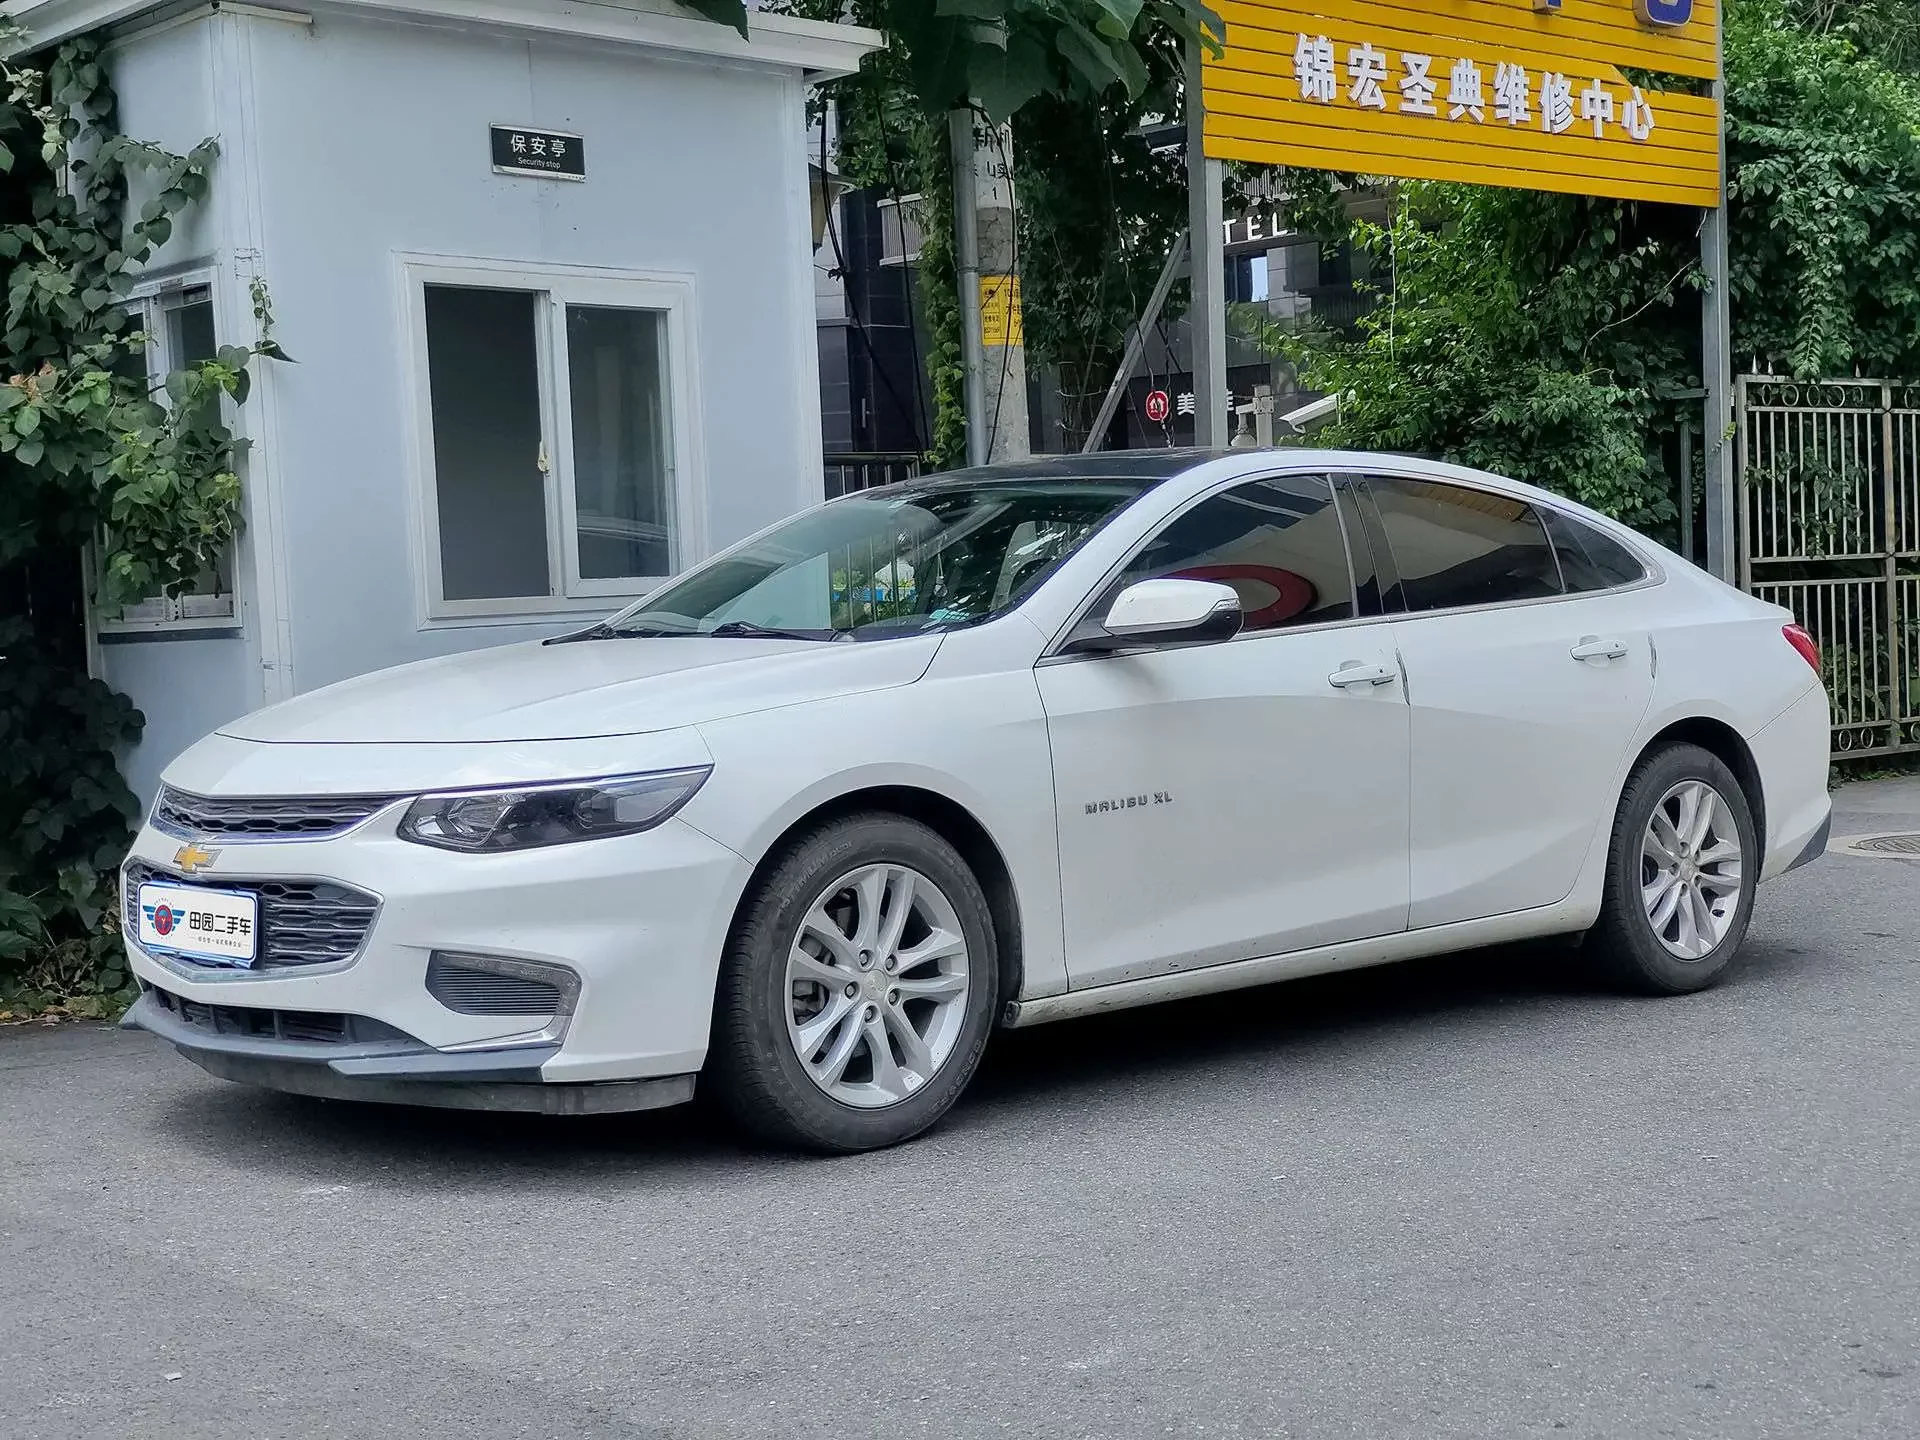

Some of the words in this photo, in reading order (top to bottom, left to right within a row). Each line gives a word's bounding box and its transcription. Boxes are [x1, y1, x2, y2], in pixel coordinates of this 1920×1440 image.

[1292, 32, 1655, 140] 锦宏圣典维修中心
[510, 133, 566, 157] 保安亭
[518, 157, 545, 168] Security
[546, 161, 561, 169] stop
[1085, 795, 1148, 814] MALIBU
[1153, 791, 1173, 804] XL
[189, 911, 252, 936] 田园二手车
